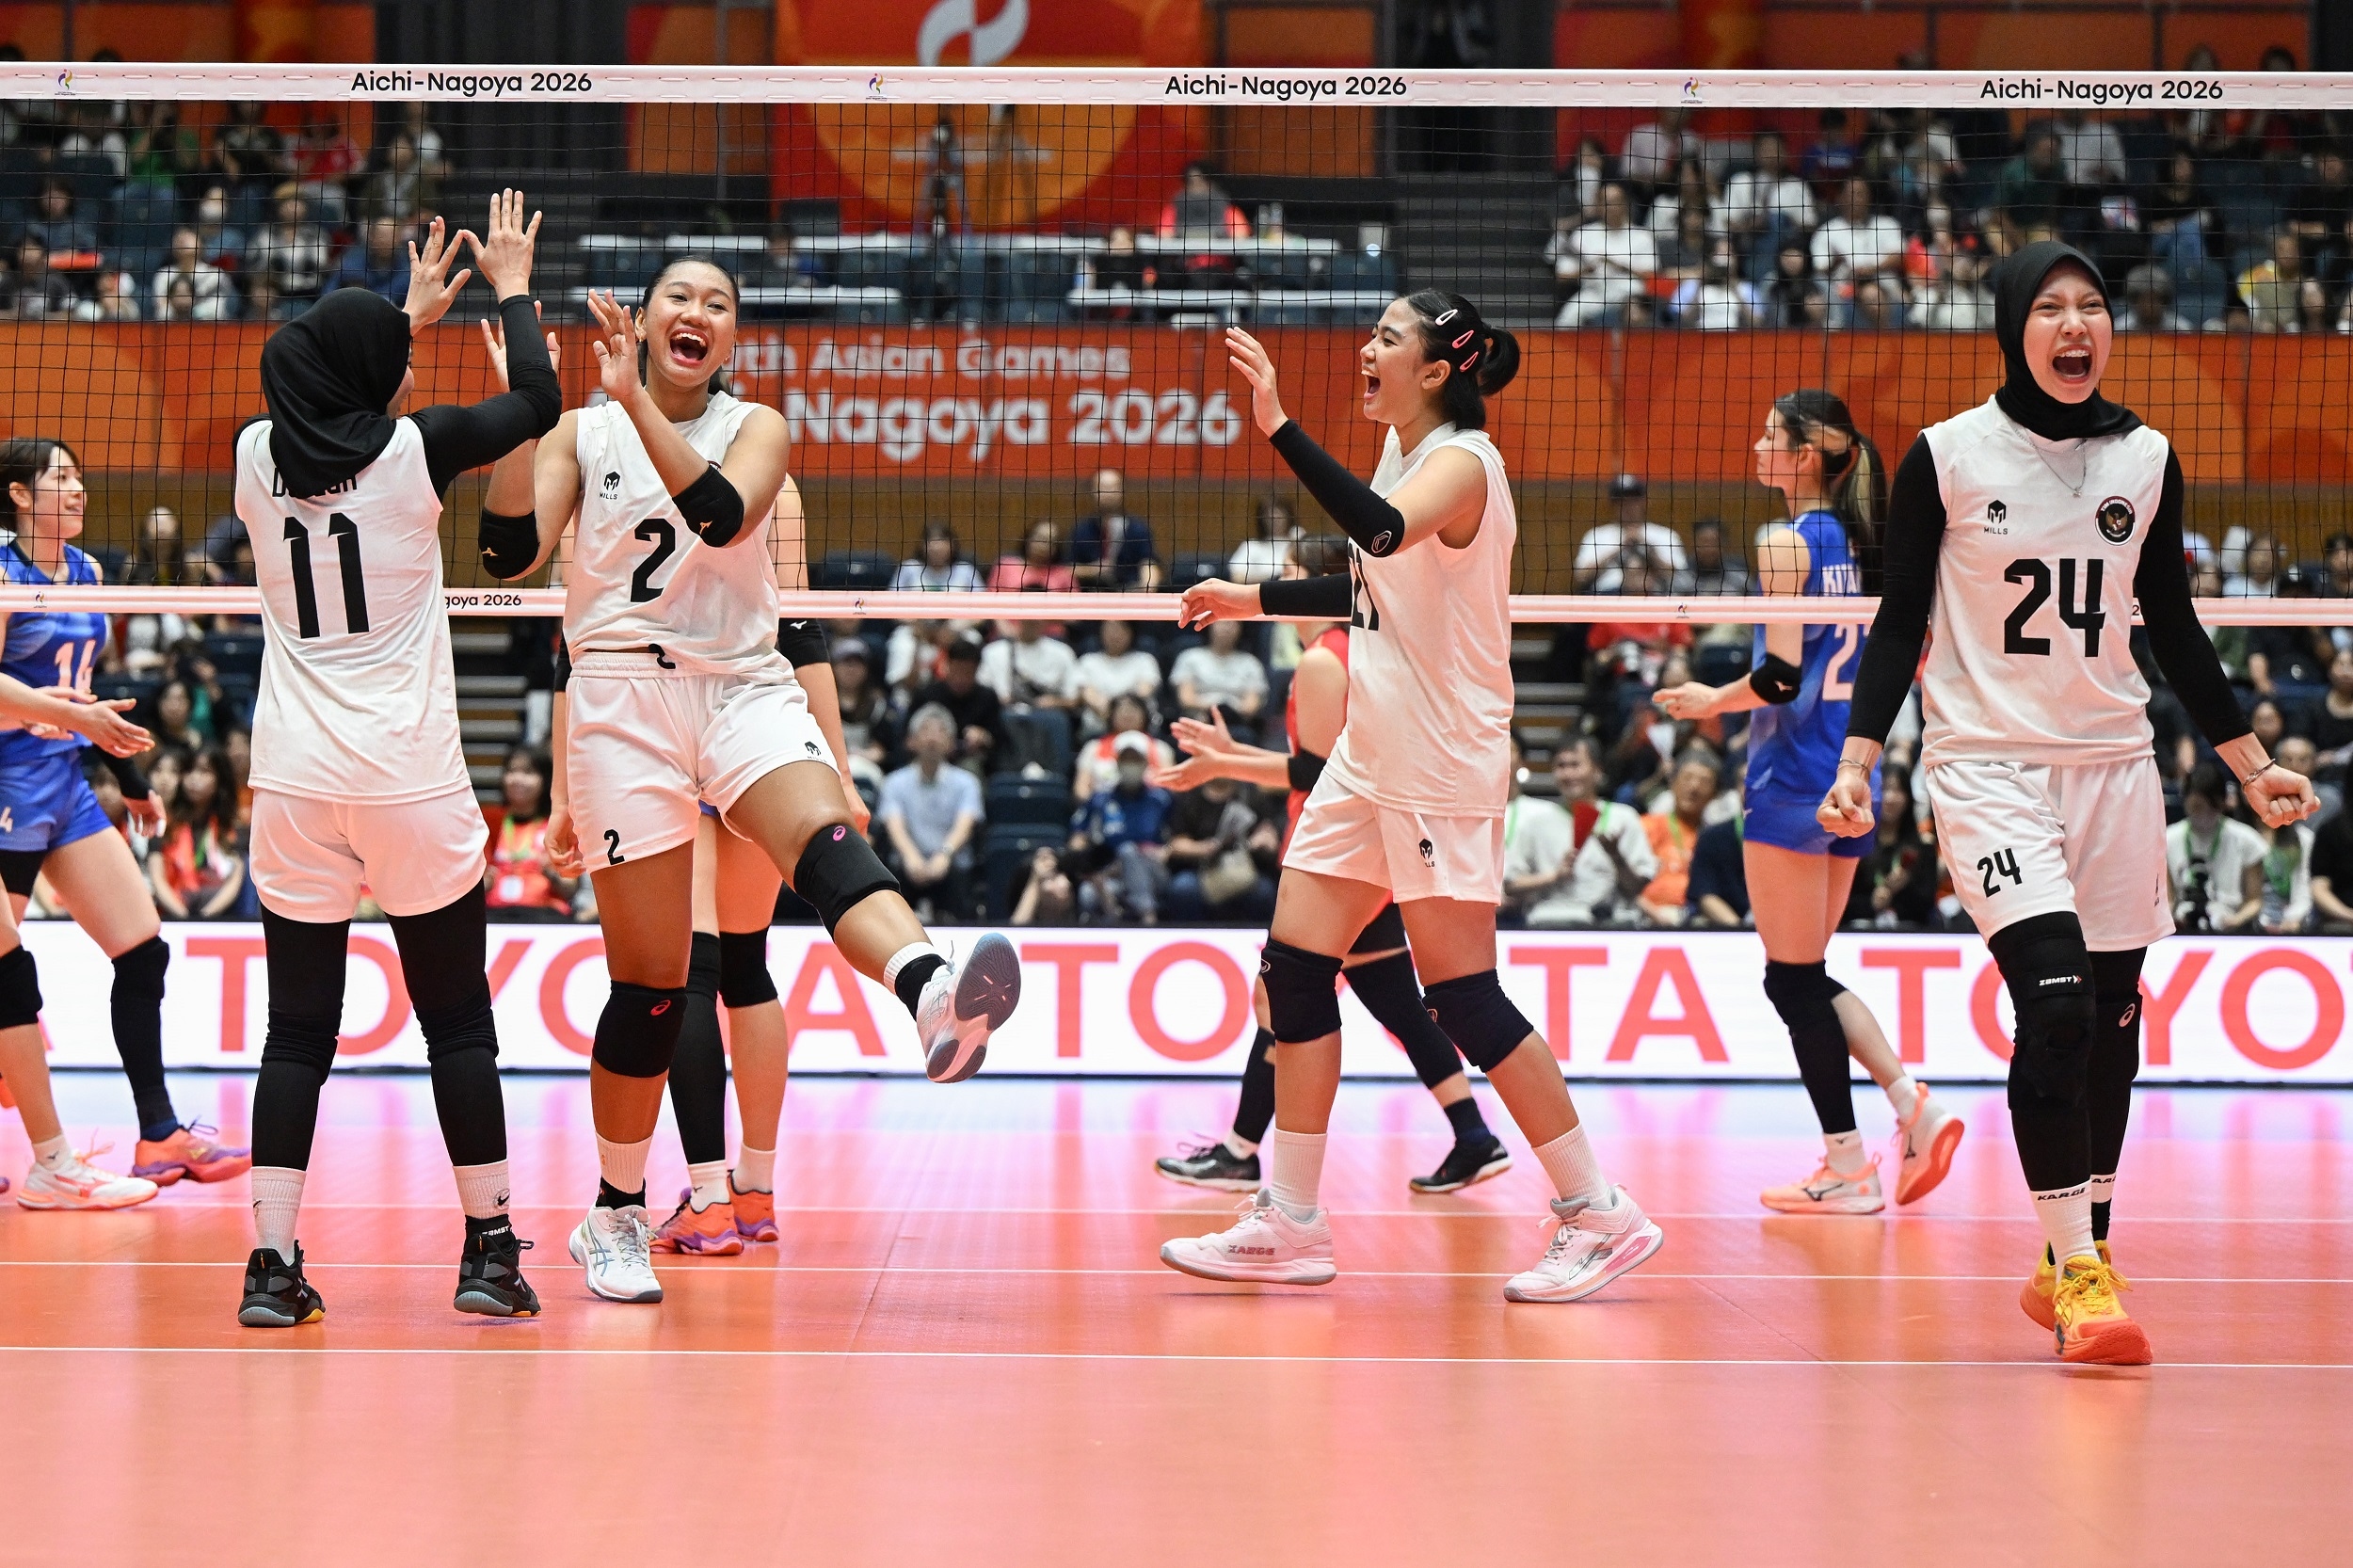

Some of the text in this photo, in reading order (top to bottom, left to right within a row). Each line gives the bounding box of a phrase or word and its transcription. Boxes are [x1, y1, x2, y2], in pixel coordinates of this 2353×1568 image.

[351, 71, 593, 97] Aichi-Nagoya 2026
[1165, 74, 1407, 101] Aichi-Nagoya 2026
[1980, 78, 2223, 104] Aichi-Nagoya 2026
[808, 333, 944, 378] Asian
[956, 338, 1131, 379] Games
[732, 384, 1241, 463] Nagoya 2026
[282, 512, 369, 639] 11
[631, 518, 676, 602] 2
[483, 594, 522, 606] 2026
[2004, 558, 2106, 657] 24
[1822, 623, 1869, 700] 2
[603, 828, 626, 865] 2
[1977, 848, 2023, 898] 24
[1020, 940, 1731, 1063] TOTA
